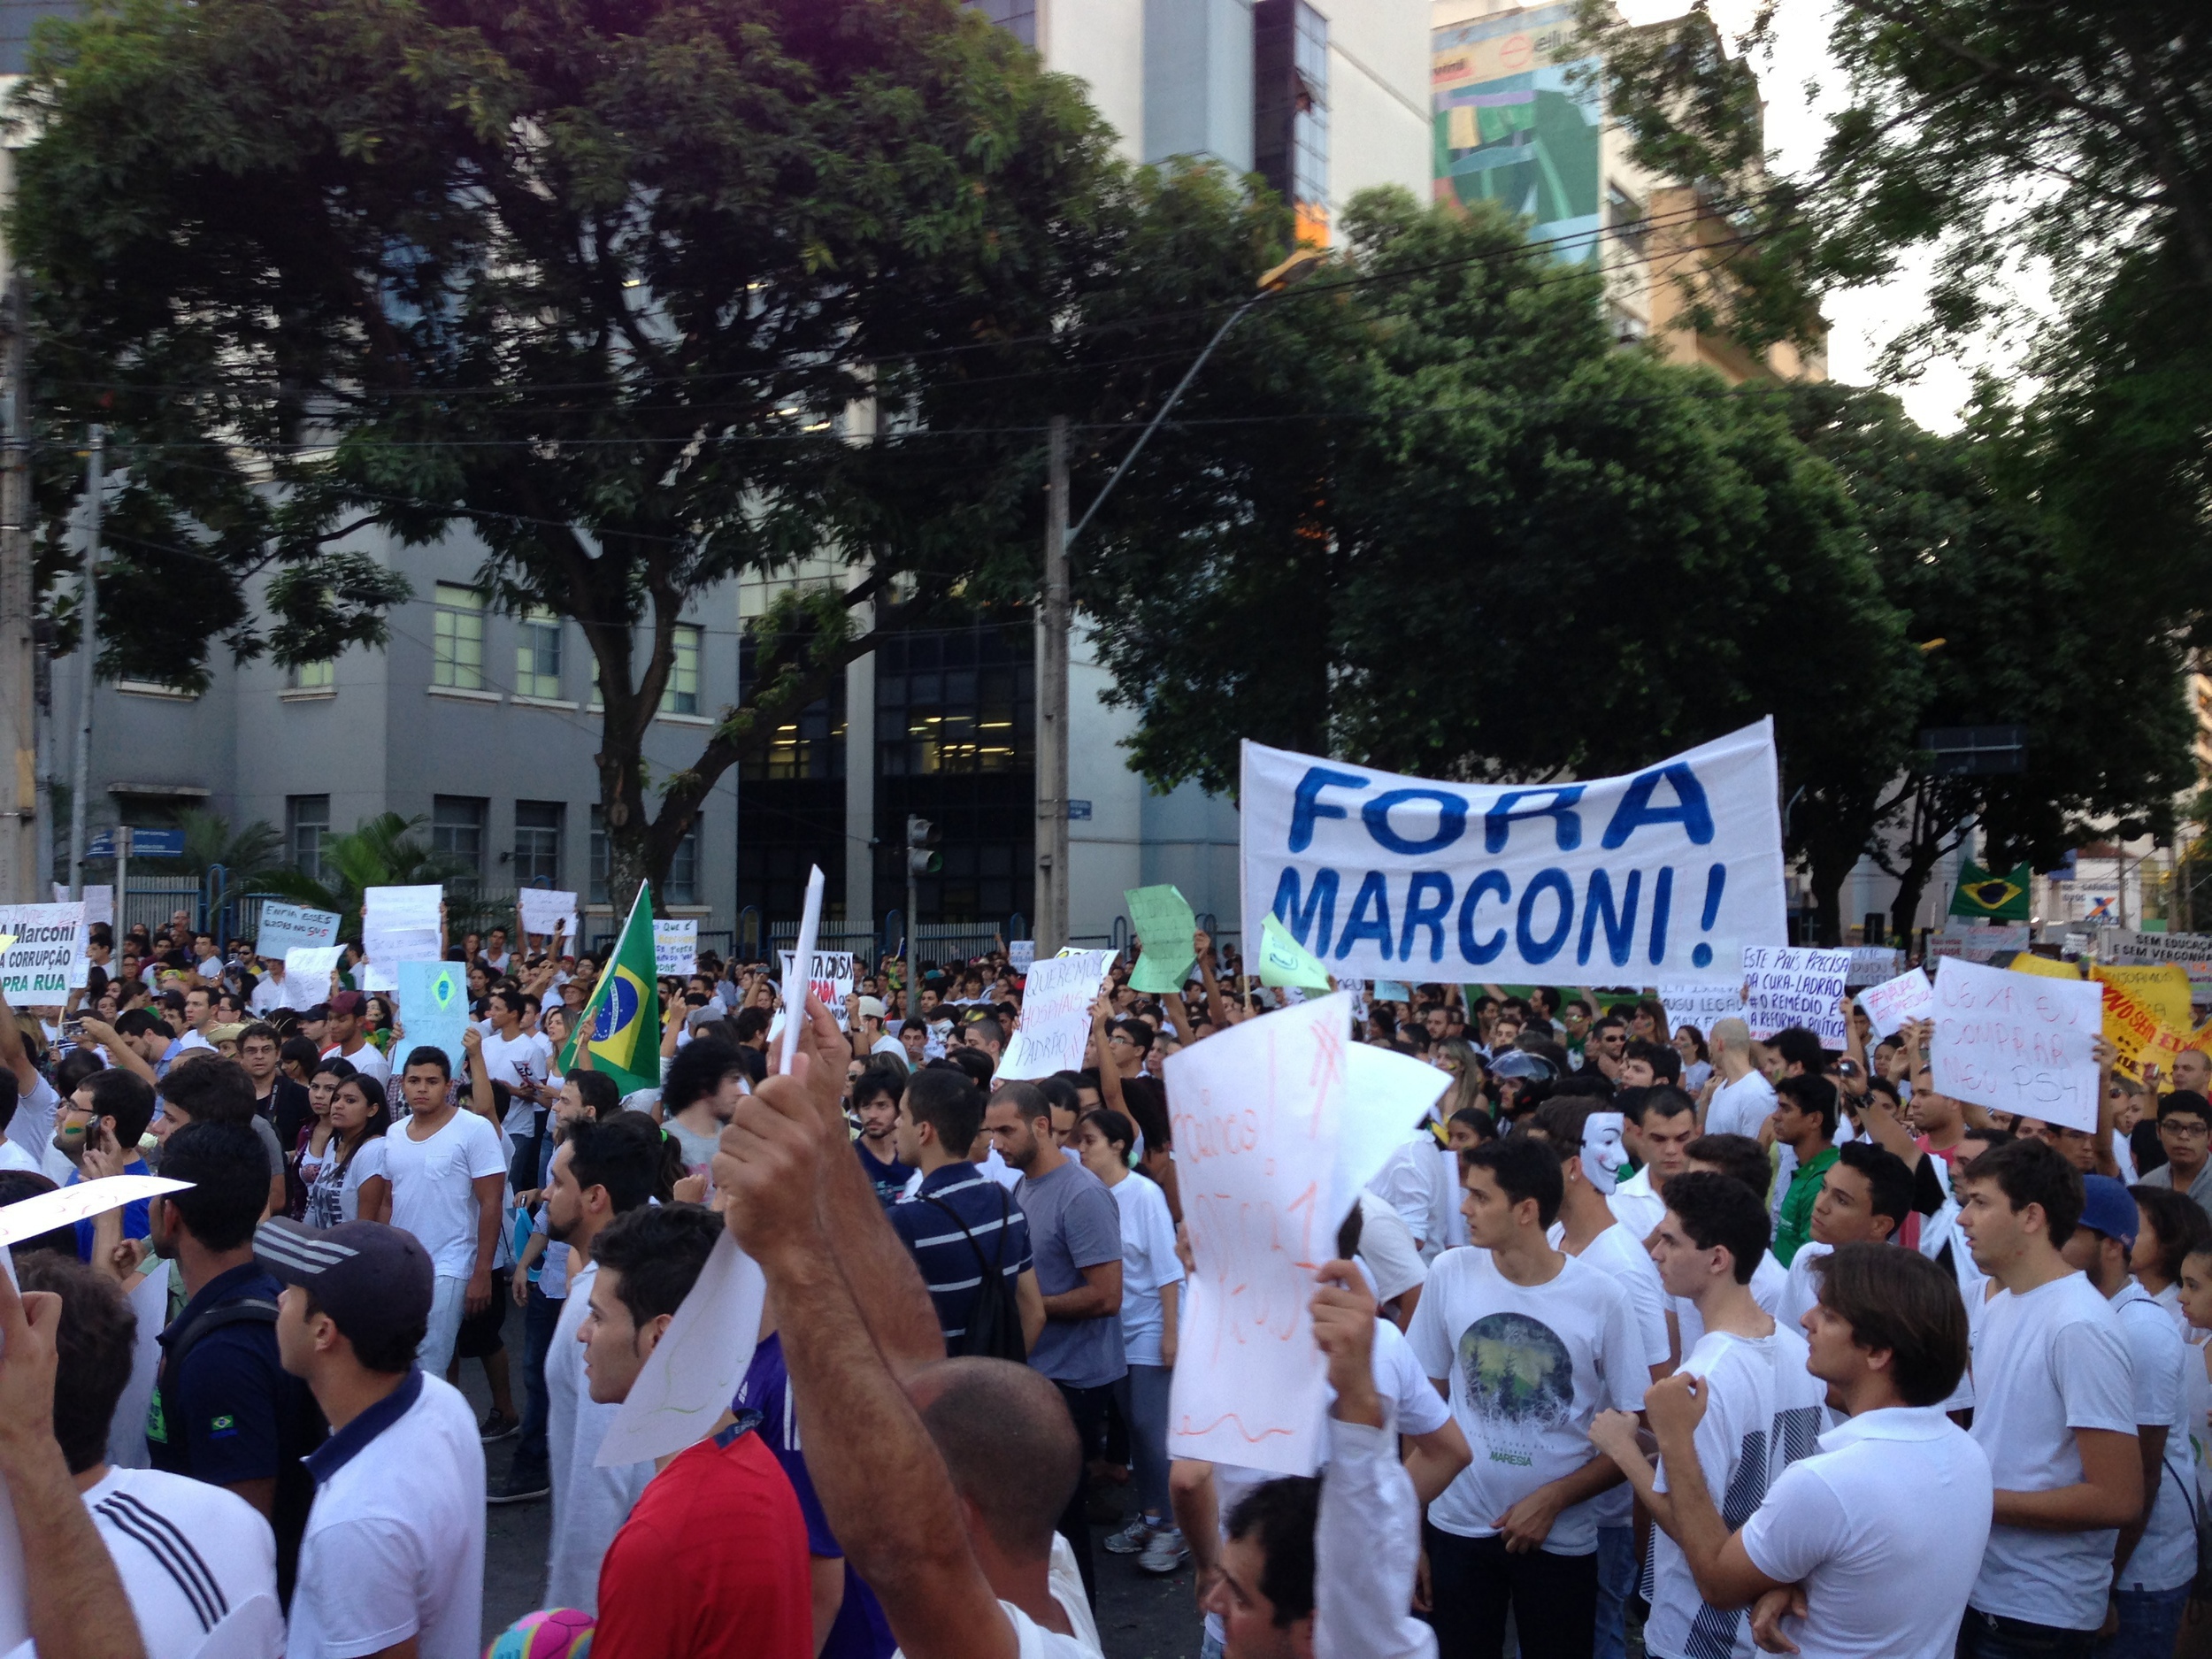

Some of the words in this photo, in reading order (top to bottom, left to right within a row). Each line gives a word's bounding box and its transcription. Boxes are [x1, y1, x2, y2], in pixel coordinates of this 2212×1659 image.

[1287, 762, 1715, 855] FORA
[13, 920, 75, 944] Marconi
[2136, 934, 2161, 947] SEM
[9, 945, 71, 971] CORRUPÇÃO
[1743, 947, 1769, 969] ESTE
[1805, 950, 1850, 973] PRECISA
[2124, 944, 2147, 956] SEM
[3, 975, 28, 992] PRA
[33, 973, 66, 991] RUA
[1772, 993, 1823, 1016] REMÉDIO
[1750, 1011, 1758, 1026] A
[1760, 1010, 1803, 1028] REFORMA
[1809, 1016, 1846, 1038] POLÍTICA
[1016, 1031, 1067, 1067] PADRÃO
[1942, 1018, 2073, 1070] COMPRAR
[1489, 1450, 1533, 1467] MARESIA
